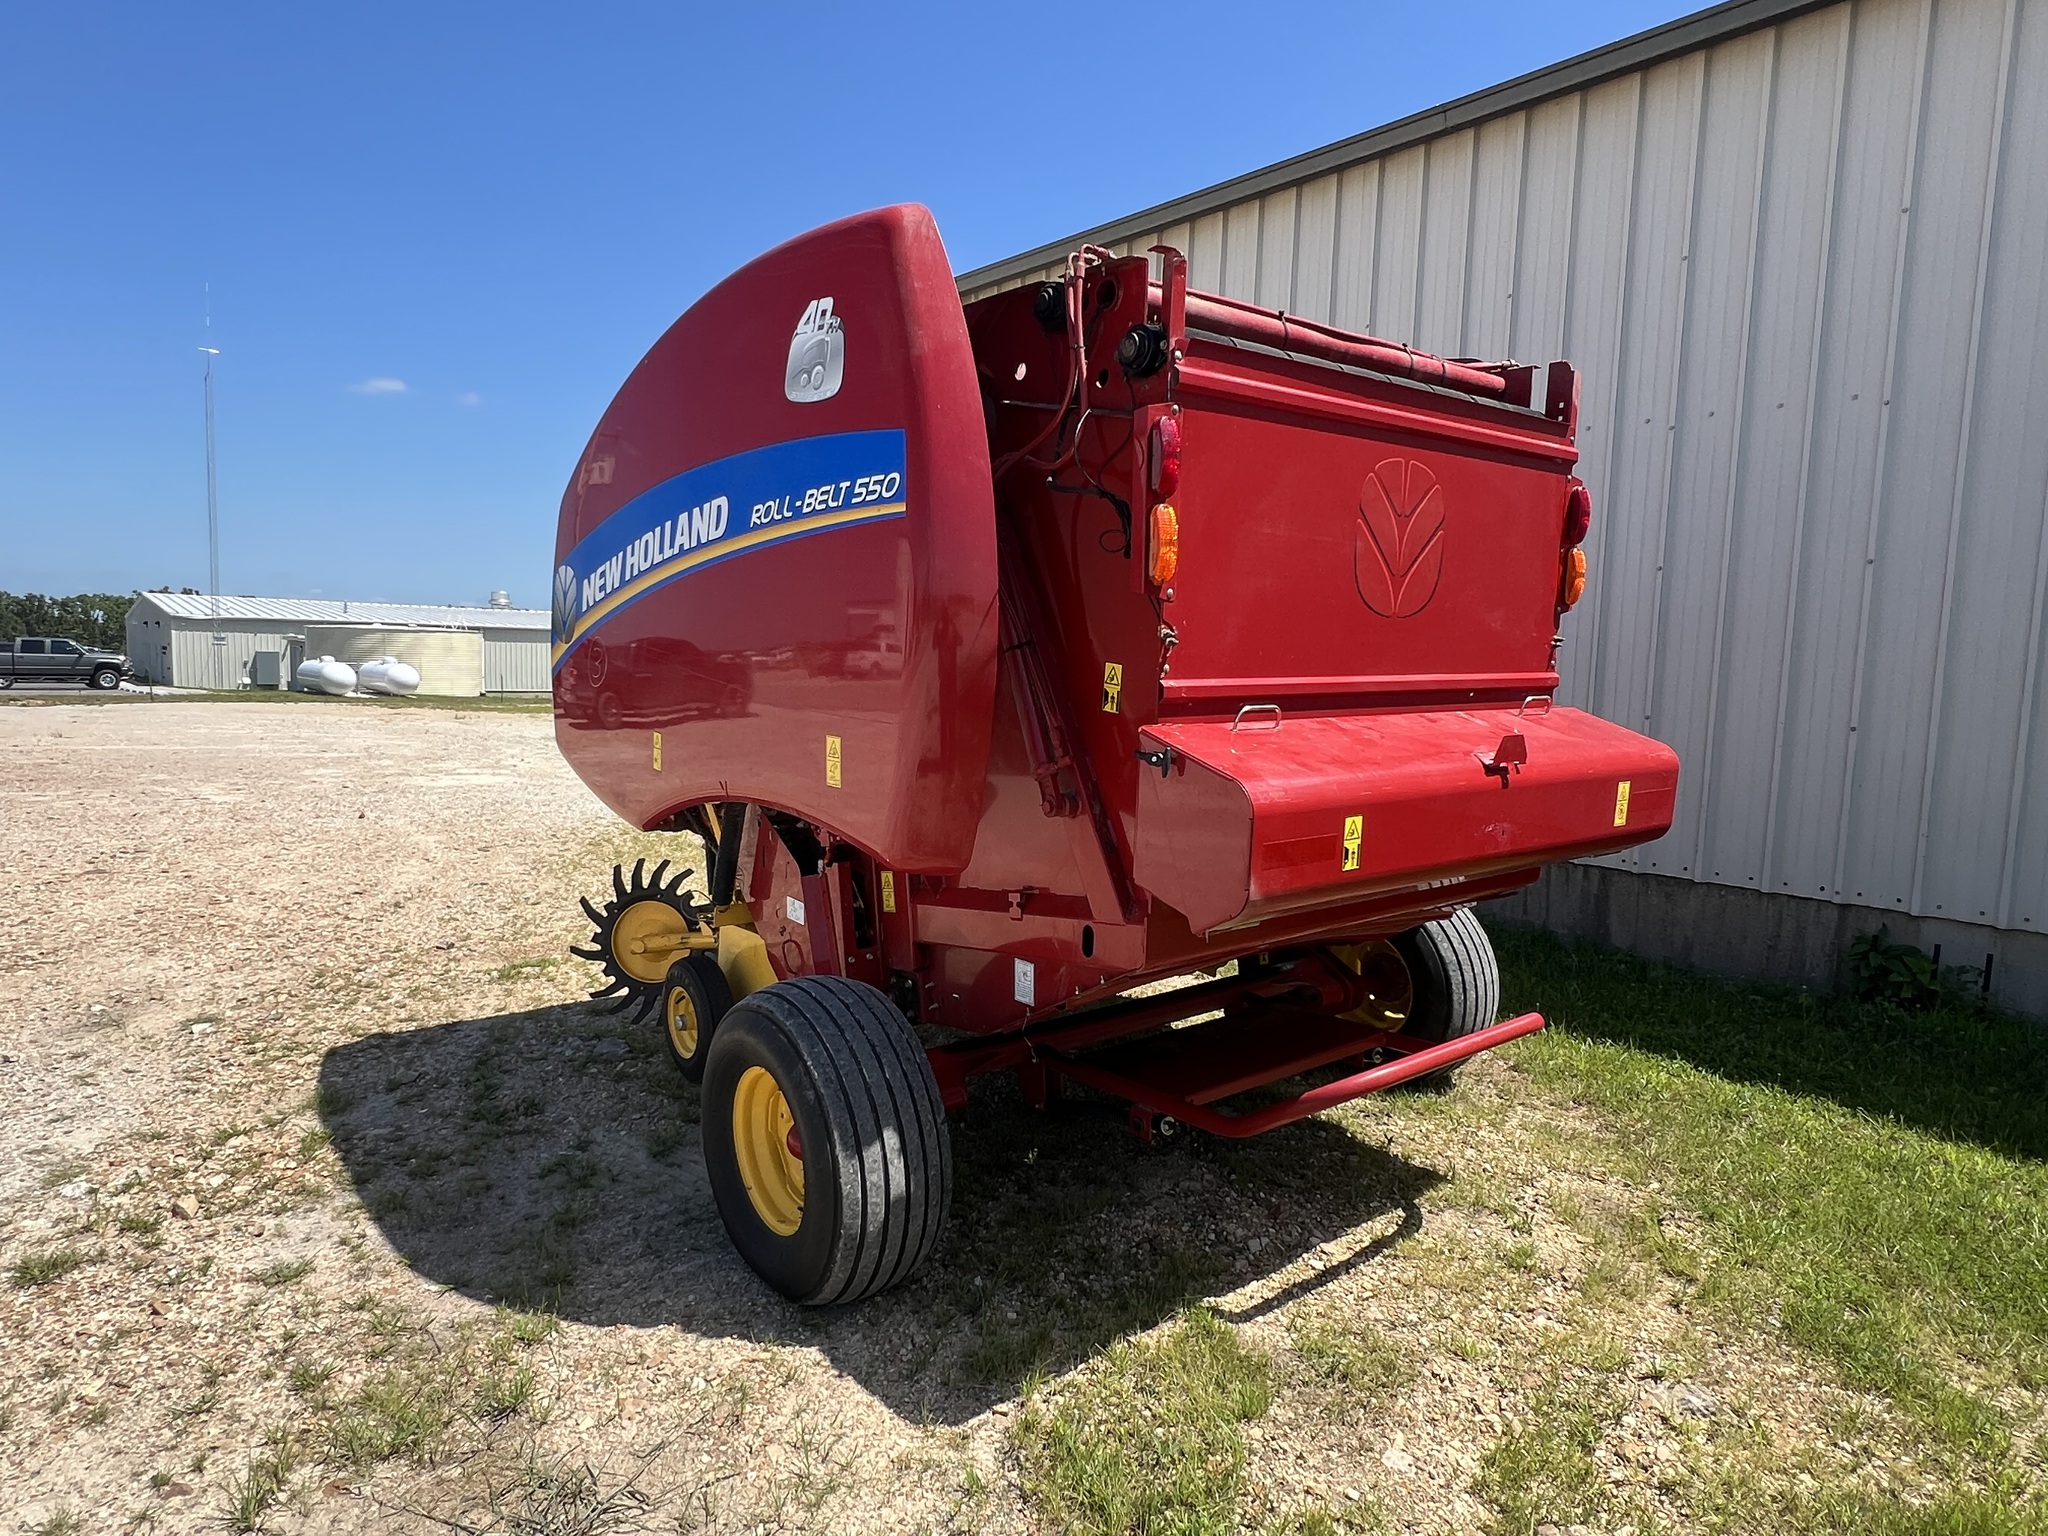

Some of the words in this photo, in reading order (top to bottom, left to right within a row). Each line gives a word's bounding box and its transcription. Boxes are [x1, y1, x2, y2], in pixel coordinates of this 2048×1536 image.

[750, 481, 850, 527] ROLL-BELT
[851, 472, 900, 504] 550
[582, 551, 624, 612] NEW
[625, 496, 729, 581] HOLLAND
